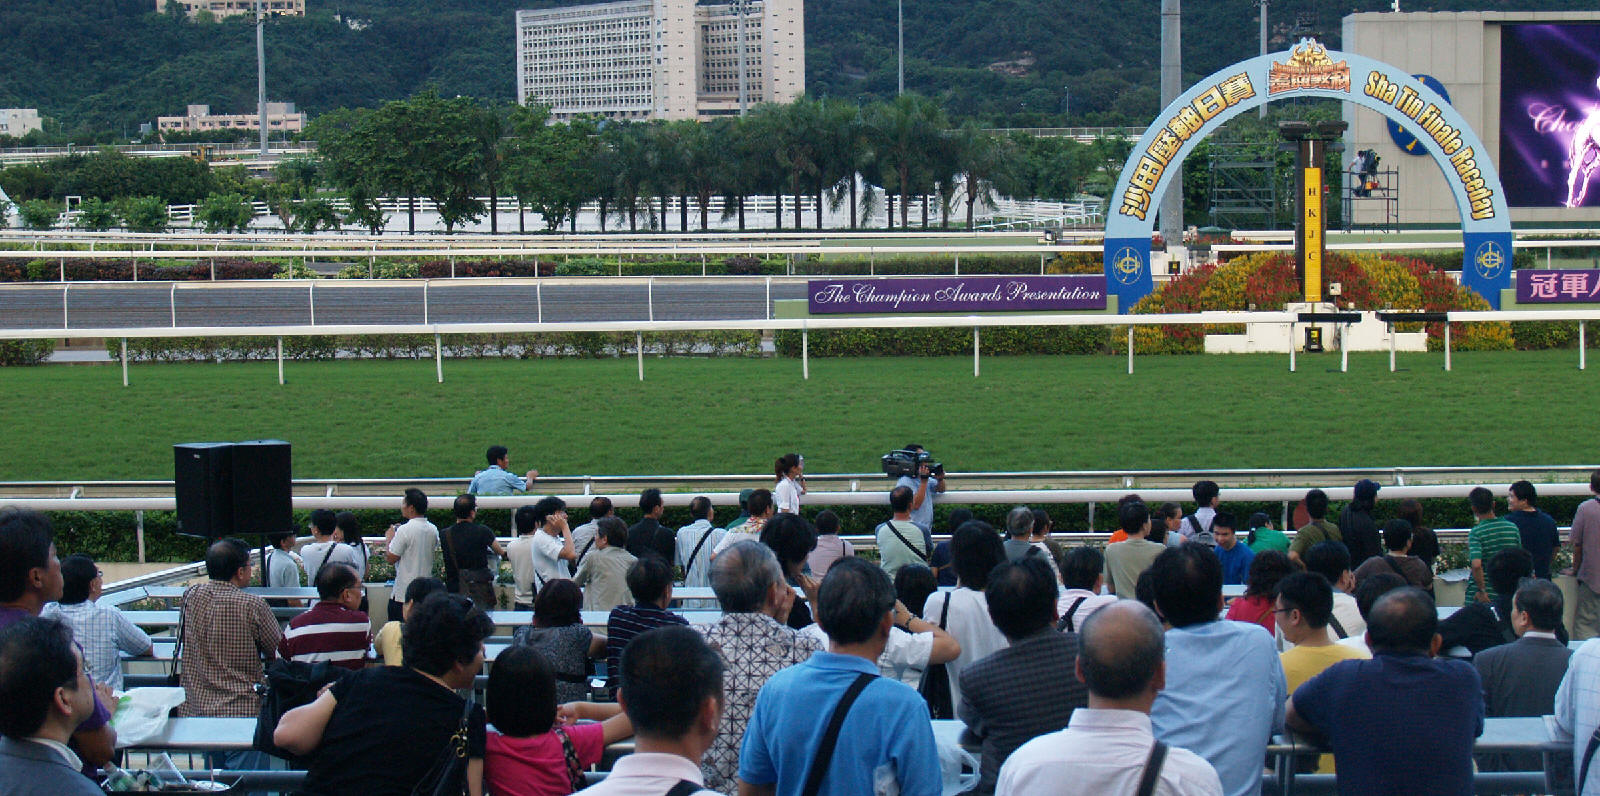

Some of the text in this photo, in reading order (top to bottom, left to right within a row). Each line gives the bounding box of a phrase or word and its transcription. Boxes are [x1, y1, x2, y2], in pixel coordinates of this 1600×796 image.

[1364, 70, 1495, 221] Sha Tin Finale Raceday
[815, 280, 1101, 309] The Champion Awards Presentation
